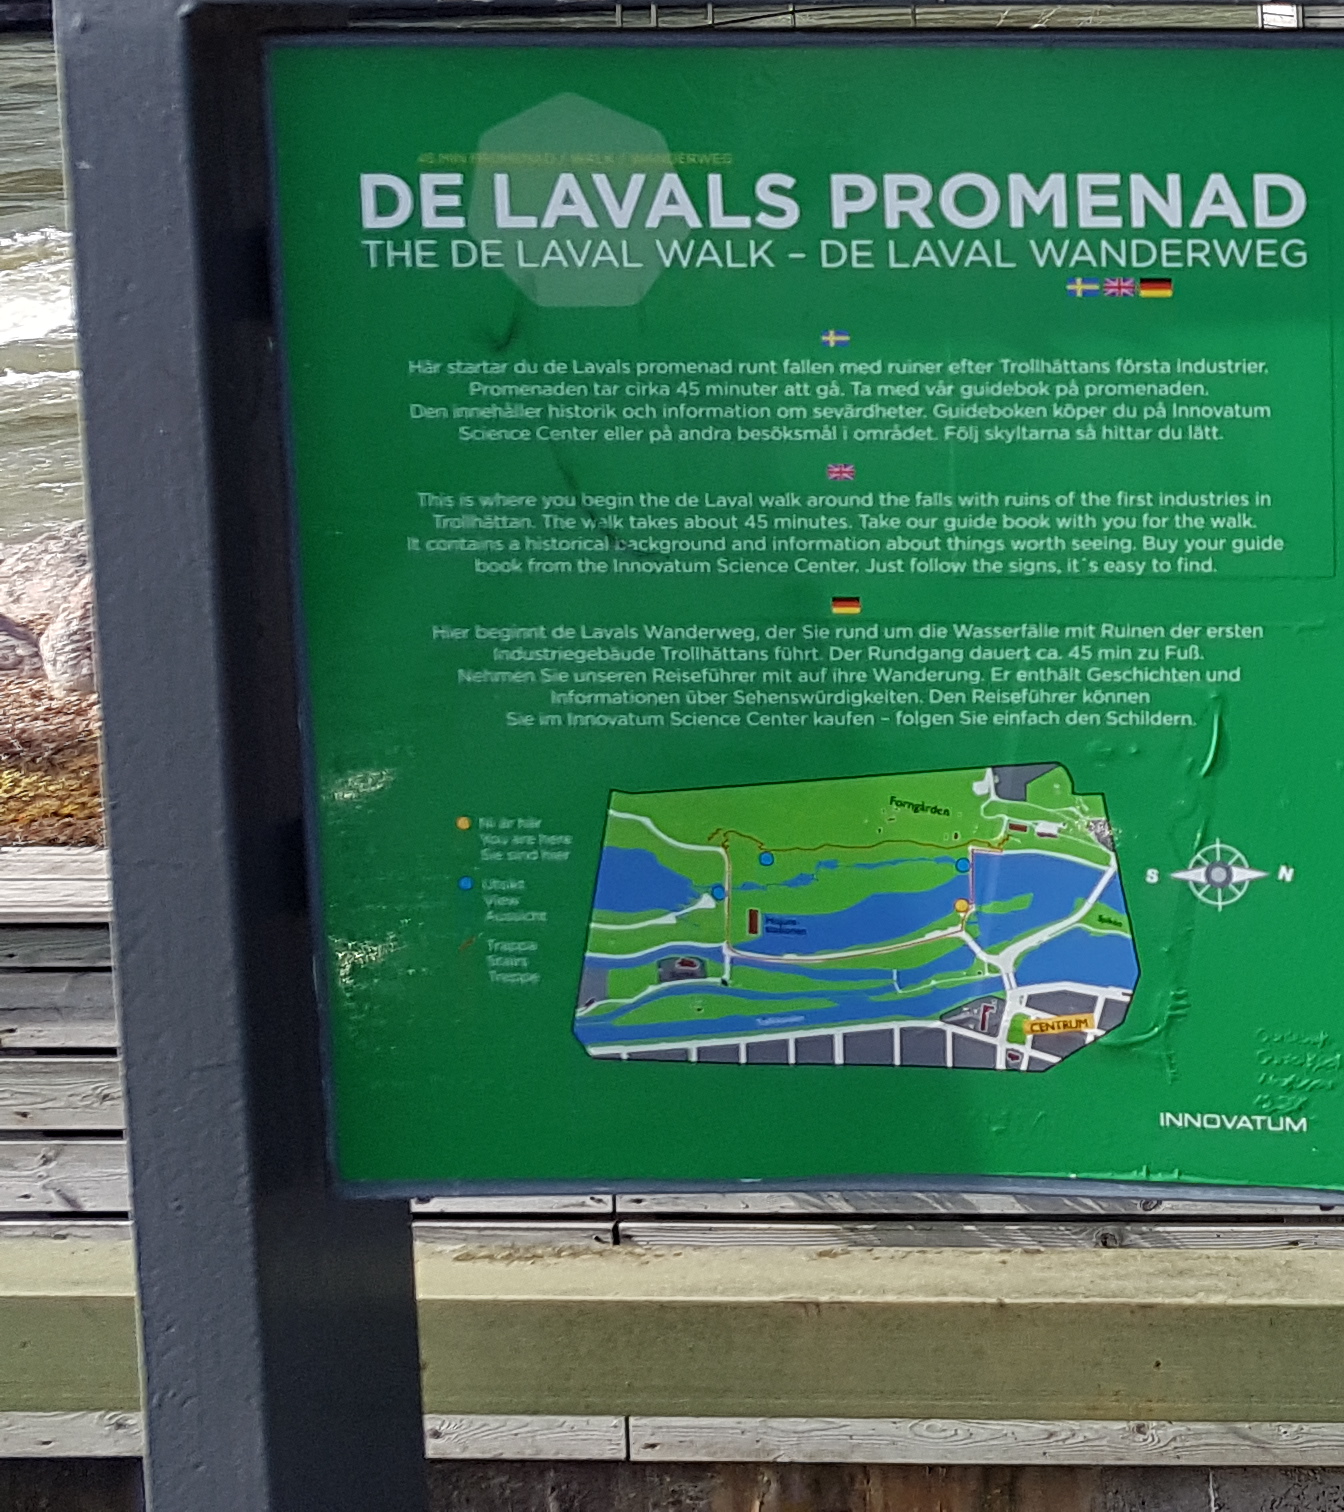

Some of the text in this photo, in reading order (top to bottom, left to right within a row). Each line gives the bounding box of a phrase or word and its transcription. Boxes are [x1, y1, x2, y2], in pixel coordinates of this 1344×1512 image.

[359, 171, 1308, 230] DE LAVALS PROMENAD
[361, 239, 439, 268] THE
[451, 239, 504, 268] DE
[517, 239, 644, 268] LAVAL
[656, 239, 775, 268] WALK
[820, 239, 874, 268] DE
[888, 239, 1017, 268] LAVAL
[1030, 238, 1308, 268] WANDERWEG
[573, 359, 630, 374] Lavals
[637, 359, 732, 376] promenad
[739, 361, 775, 374] runt
[784, 359, 834, 374] fallen
[840, 360, 881, 375] med
[888, 360, 941, 374] ruiner
[949, 358, 992, 374] efter
[1001, 359, 1110, 374] Trollhättans
[1117, 358, 1170, 373] första
[625, 379, 1209, 399] cirka 45 minuter att gå. Ta med vår guidebok på promenaden.
[548, 402, 1271, 420] historik och information om sevärdheter. Guideboken köper du på Innovatum
[649, 424, 672, 443] på
[678, 426, 731, 440] andra
[737, 425, 837, 440] besöksmål
[843, 426, 848, 440] i
[944, 426, 979, 443] Följ
[984, 426, 1070, 443] skyltarna
[1075, 424, 1097, 440] så
[1101, 425, 1153, 440] hittar
[1158, 425, 1182, 440] du
[1187, 425, 1223, 440] lätt.
[639, 491, 1271, 507] the de Laval walk around the falls with ruins of the first industries in
[629, 513, 1257, 531] takes about 45 minutes. Take our guide book with you for the walk.
[732, 535, 1285, 554] and information about things worth seeing. Buy your guide
[614, 559, 710, 573] Innovatum
[717, 558, 788, 573] Science
[795, 558, 859, 573] Center.
[866, 558, 904, 572] Just
[910, 558, 966, 573] follow
[973, 559, 1003, 573] the
[1009, 558, 1061, 575] signs,
[1104, 561, 1145, 575] easy
[1152, 559, 1171, 573] to
[1177, 557, 1216, 573] find.
[582, 623, 1263, 642] Lavals Wanderweg, der Sie rund um die Wasserfälle mit Ruinen der ersten
[660, 646, 769, 661] Trollhättans
[829, 646, 862, 661] Der
[868, 646, 964, 663] Rundgang
[969, 646, 1031, 661] dauert
[1035, 649, 1063, 660] ca.
[1068, 645, 1092, 660] 45
[1097, 646, 1132, 660] min
[1137, 649, 1159, 660] zu
[1165, 645, 1204, 660] Fuß.
[652, 667, 1240, 684] Reiseführer mit auf ihre Wanderung. Er enthält Geschichten und
[686, 689, 1149, 706] über Sehenswürdigkeiten. Den Reiseführer können
[670, 710, 1196, 728] Science Center kaufen folgen Sie einfach den Schildern.
[1145, 867, 1159, 884] S
[1277, 865, 1294, 882] N
[1030, 1019, 1089, 1033] CENTRUM
[1159, 1111, 1307, 1133] INNOVATUM
